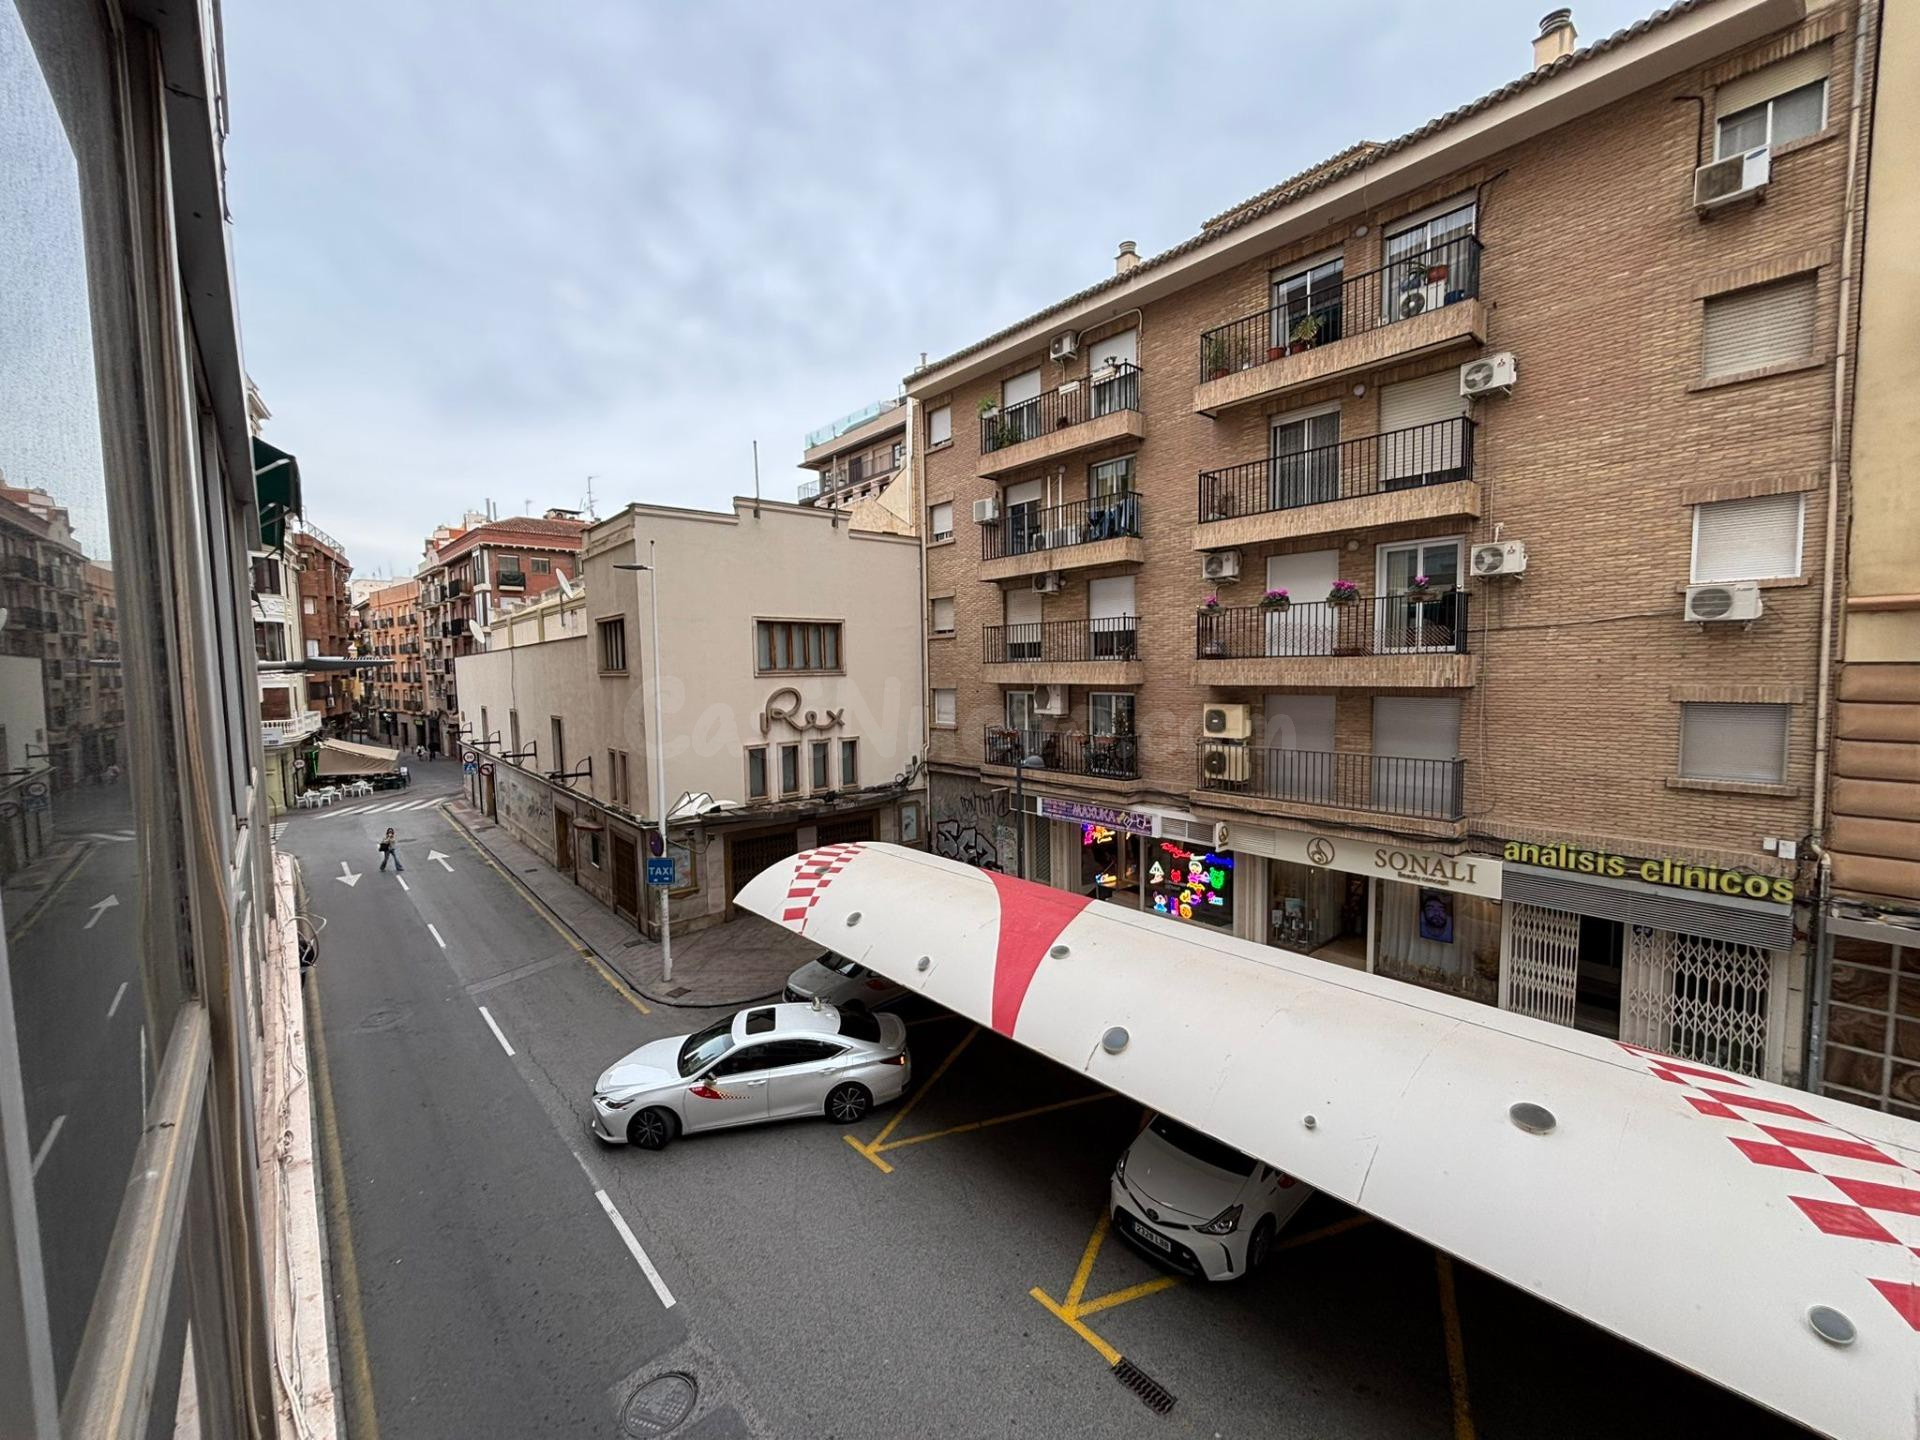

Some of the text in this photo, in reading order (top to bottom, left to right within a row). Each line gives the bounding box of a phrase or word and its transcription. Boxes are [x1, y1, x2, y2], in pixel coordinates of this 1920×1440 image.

[760, 687, 845, 736] Rex
[648, 866, 673, 876] TAXI
[1375, 848, 1476, 884] SONALI
[1503, 840, 1795, 903] análisis clínicos
